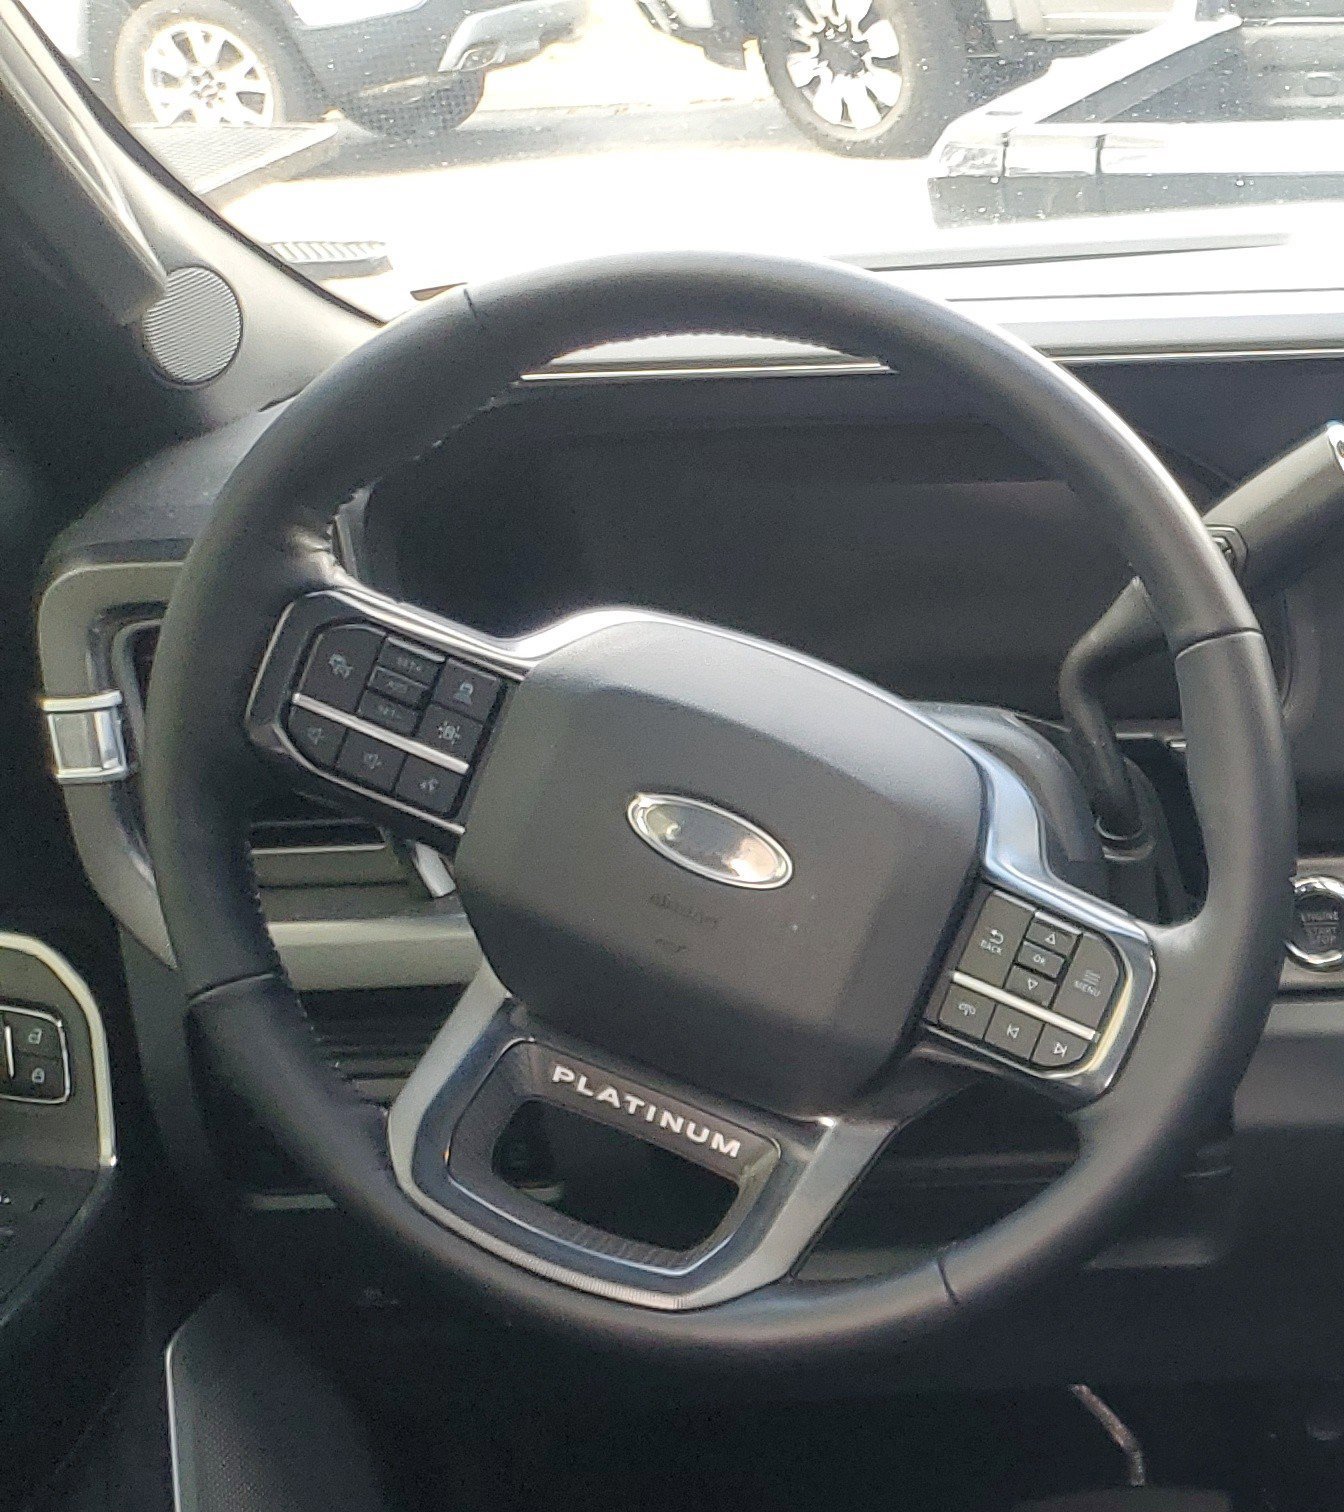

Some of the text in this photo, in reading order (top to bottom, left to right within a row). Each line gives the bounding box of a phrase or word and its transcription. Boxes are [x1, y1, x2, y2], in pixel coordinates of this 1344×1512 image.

[980, 940, 1002, 955] BACK
[1074, 980, 1100, 997] MENU
[552, 1065, 741, 1158] PLATINUM
